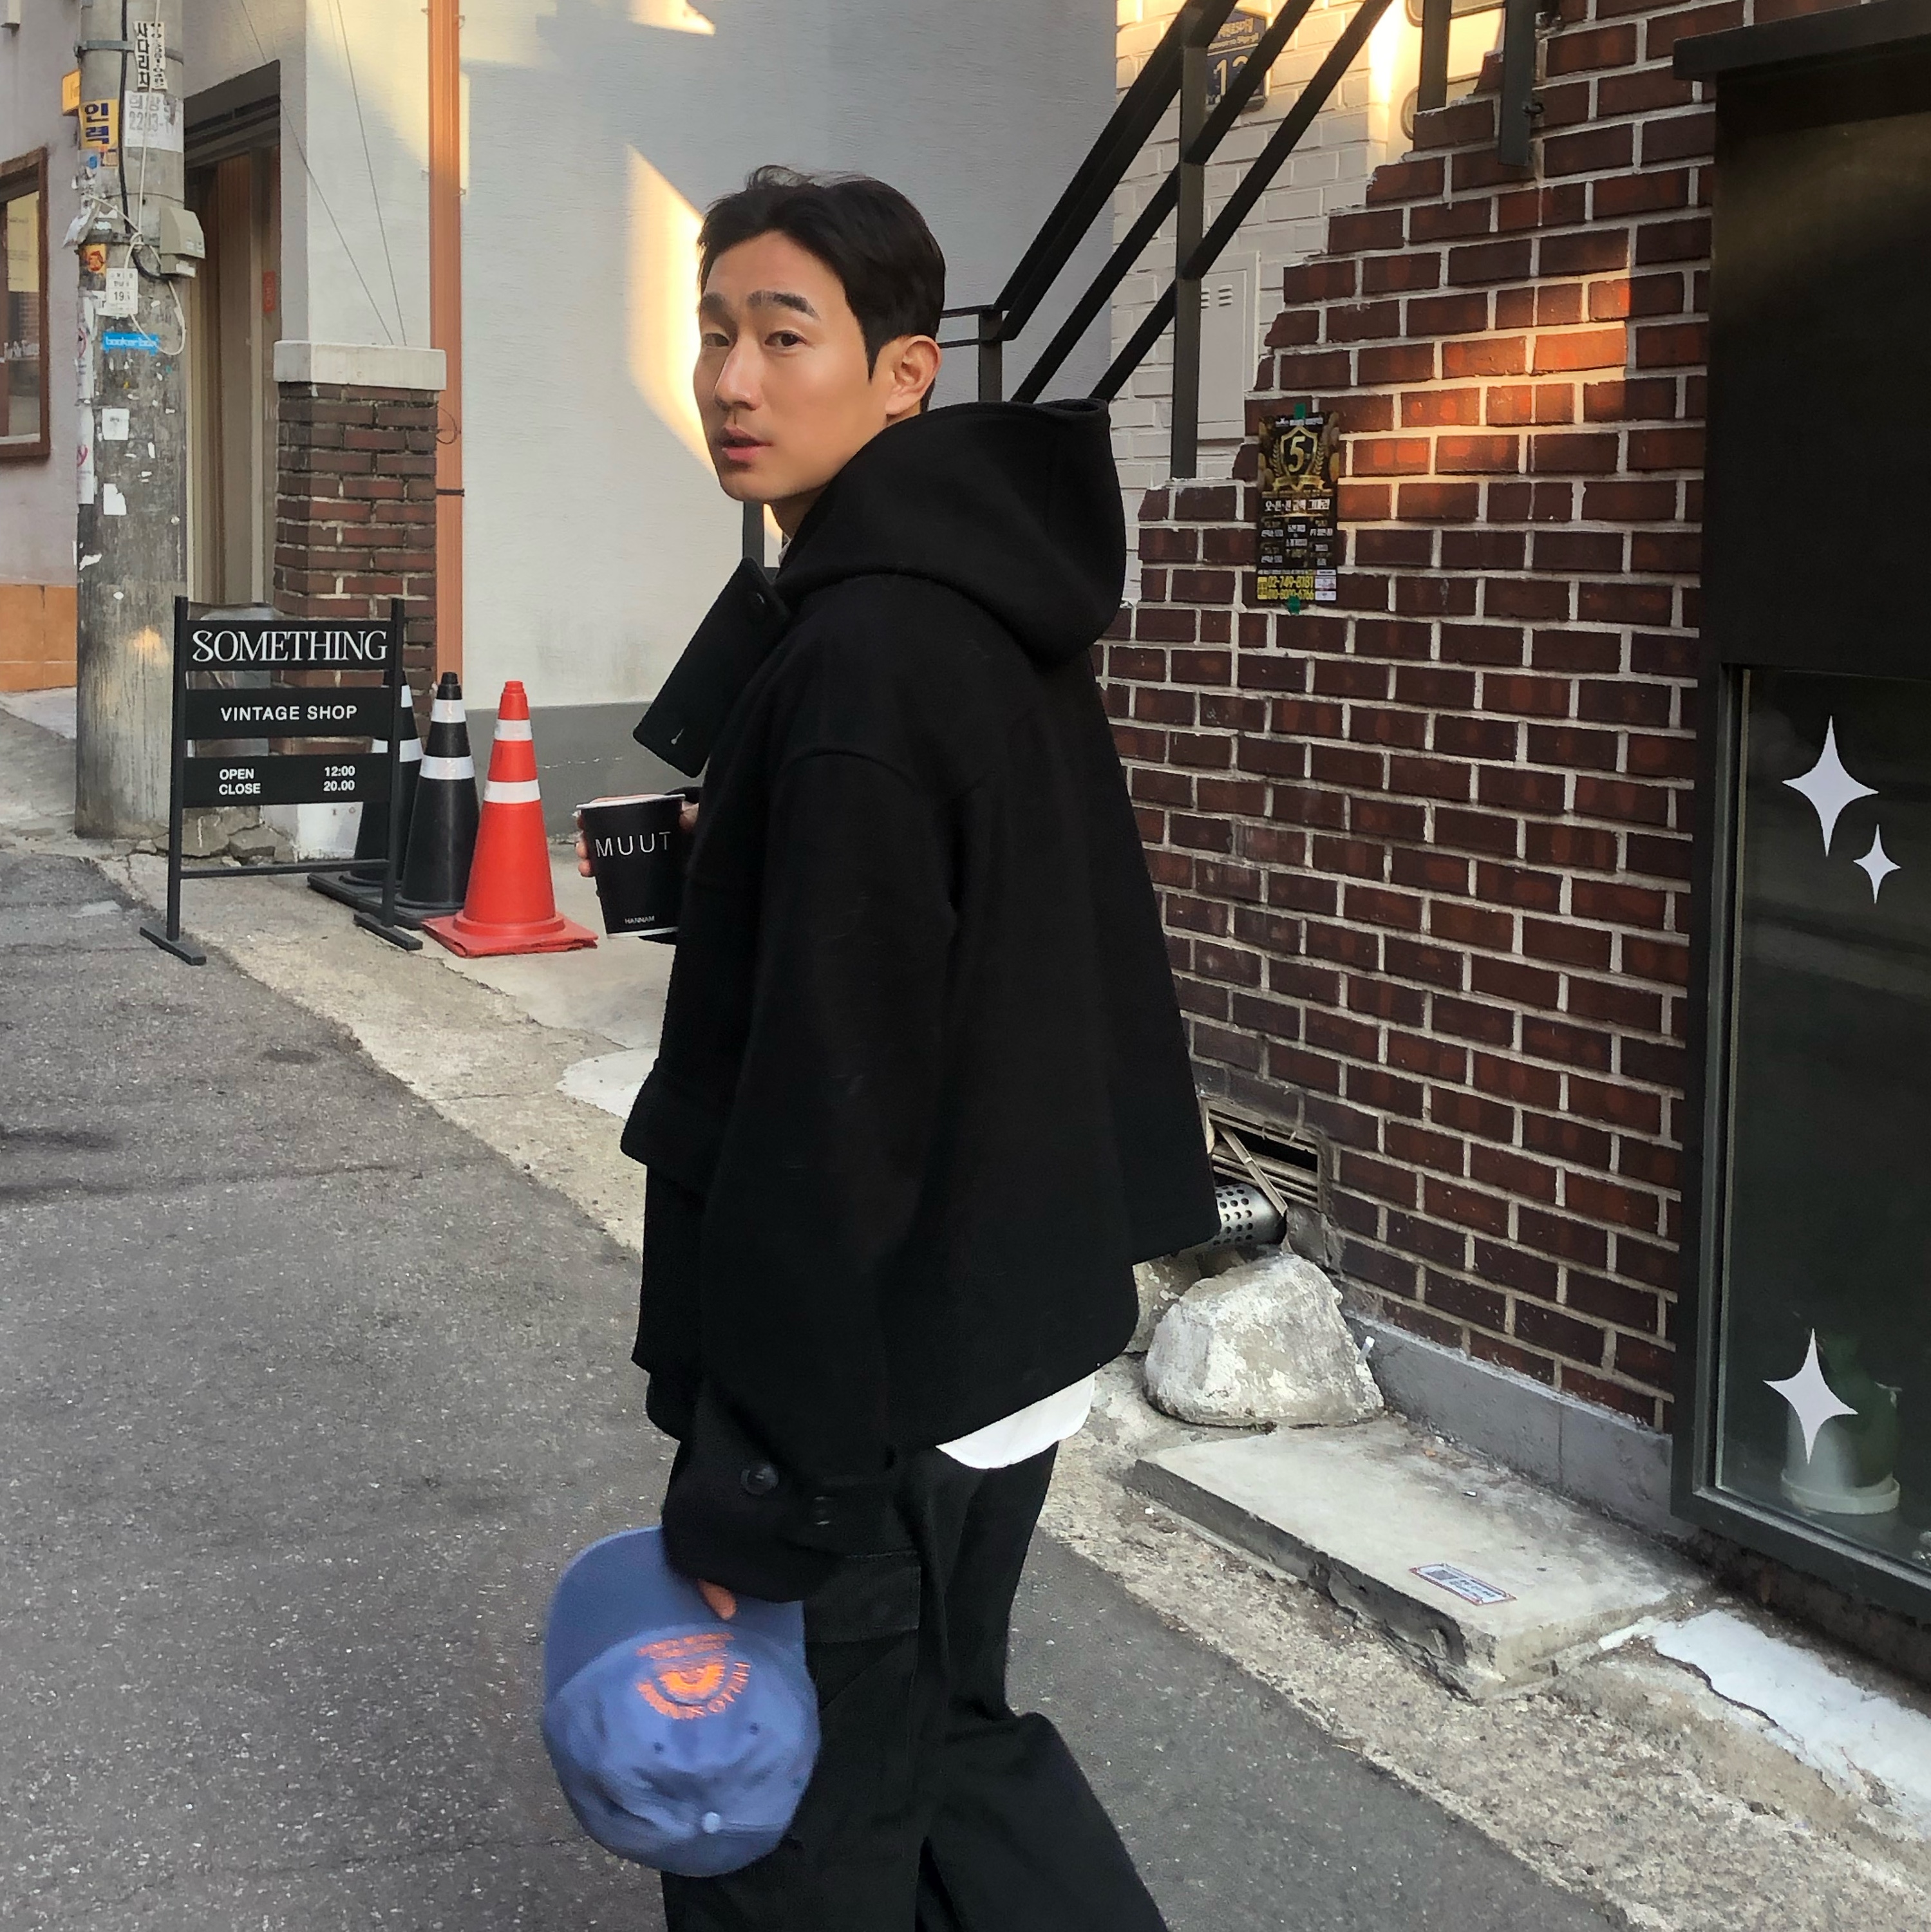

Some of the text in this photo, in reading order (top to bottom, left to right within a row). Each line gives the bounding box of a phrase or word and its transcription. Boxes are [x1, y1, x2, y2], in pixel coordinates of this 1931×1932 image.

[85, 103, 109, 144] 인력
[1288, 436, 1305, 473] 5
[192, 630, 388, 662] SOMETHING
[220, 705, 357, 722] VINTAGE SHOP
[219, 765, 355, 780] OPEN 12:00
[218, 780, 355, 796] CLOSE 20.00
[595, 831, 671, 858] MUUT
[624, 915, 655, 924] HANNAM
